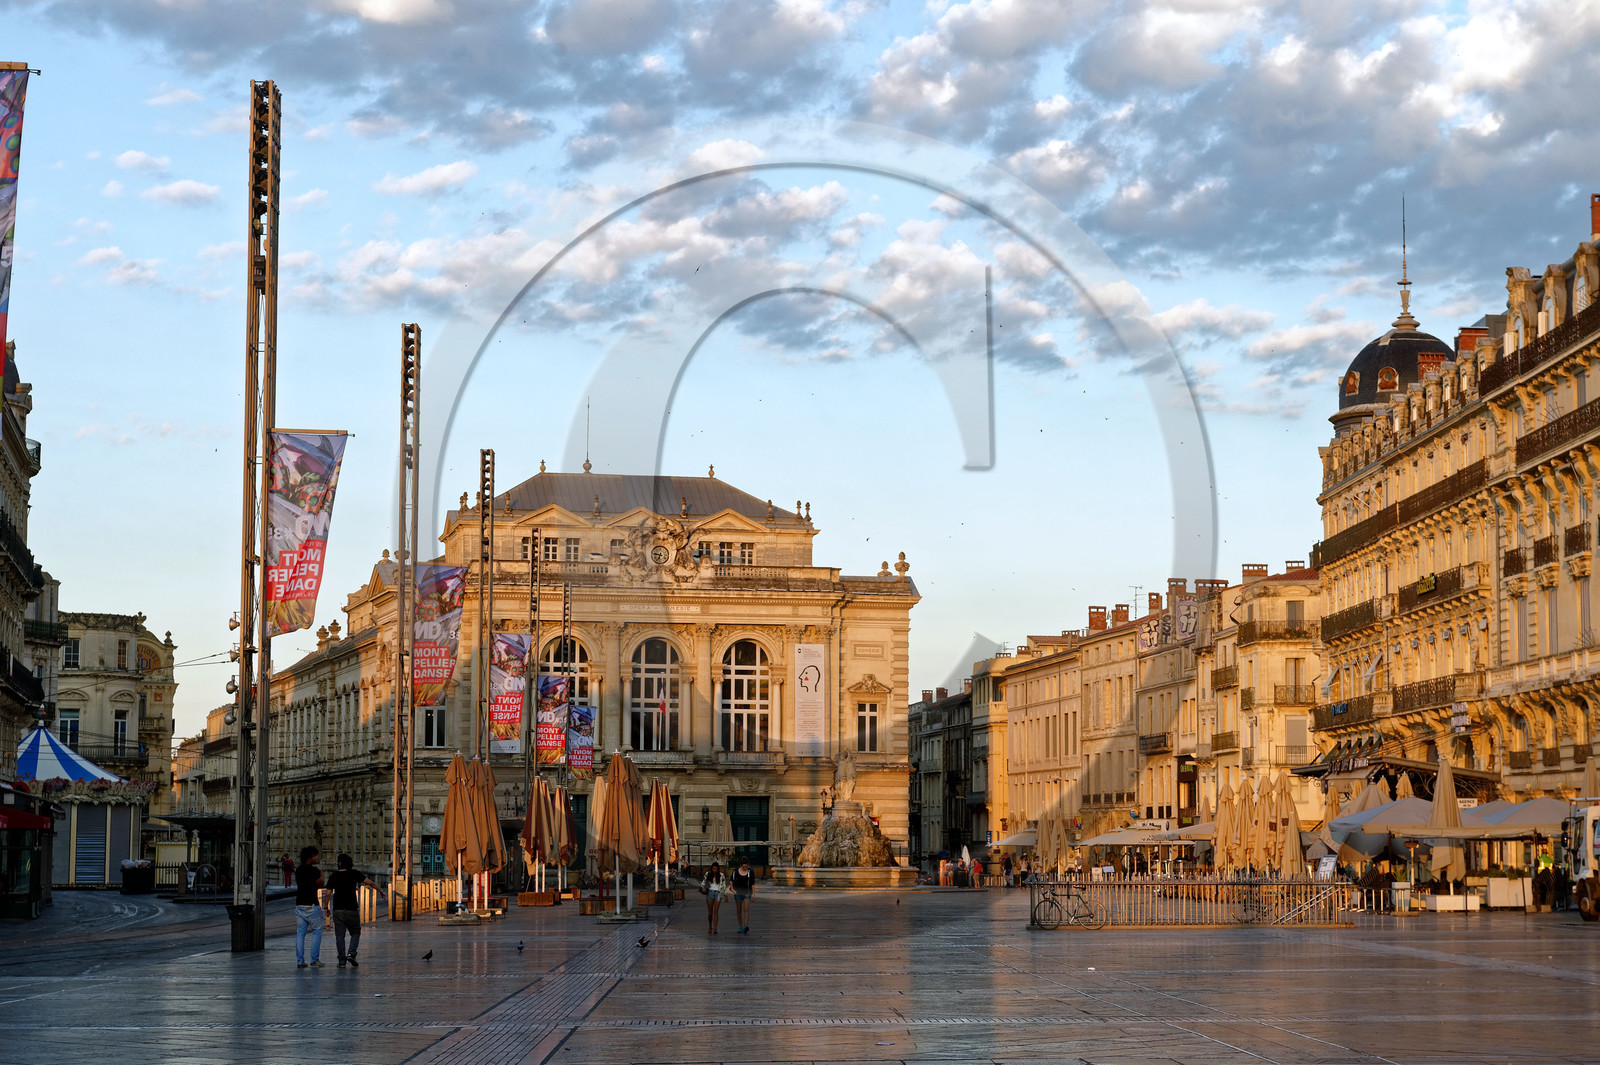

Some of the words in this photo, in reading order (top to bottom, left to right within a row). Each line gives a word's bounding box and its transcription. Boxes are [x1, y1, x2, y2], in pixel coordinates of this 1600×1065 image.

[413, 647, 448, 657] MONT
[413, 658, 456, 668] PELLIER
[413, 669, 451, 679] DANSE
